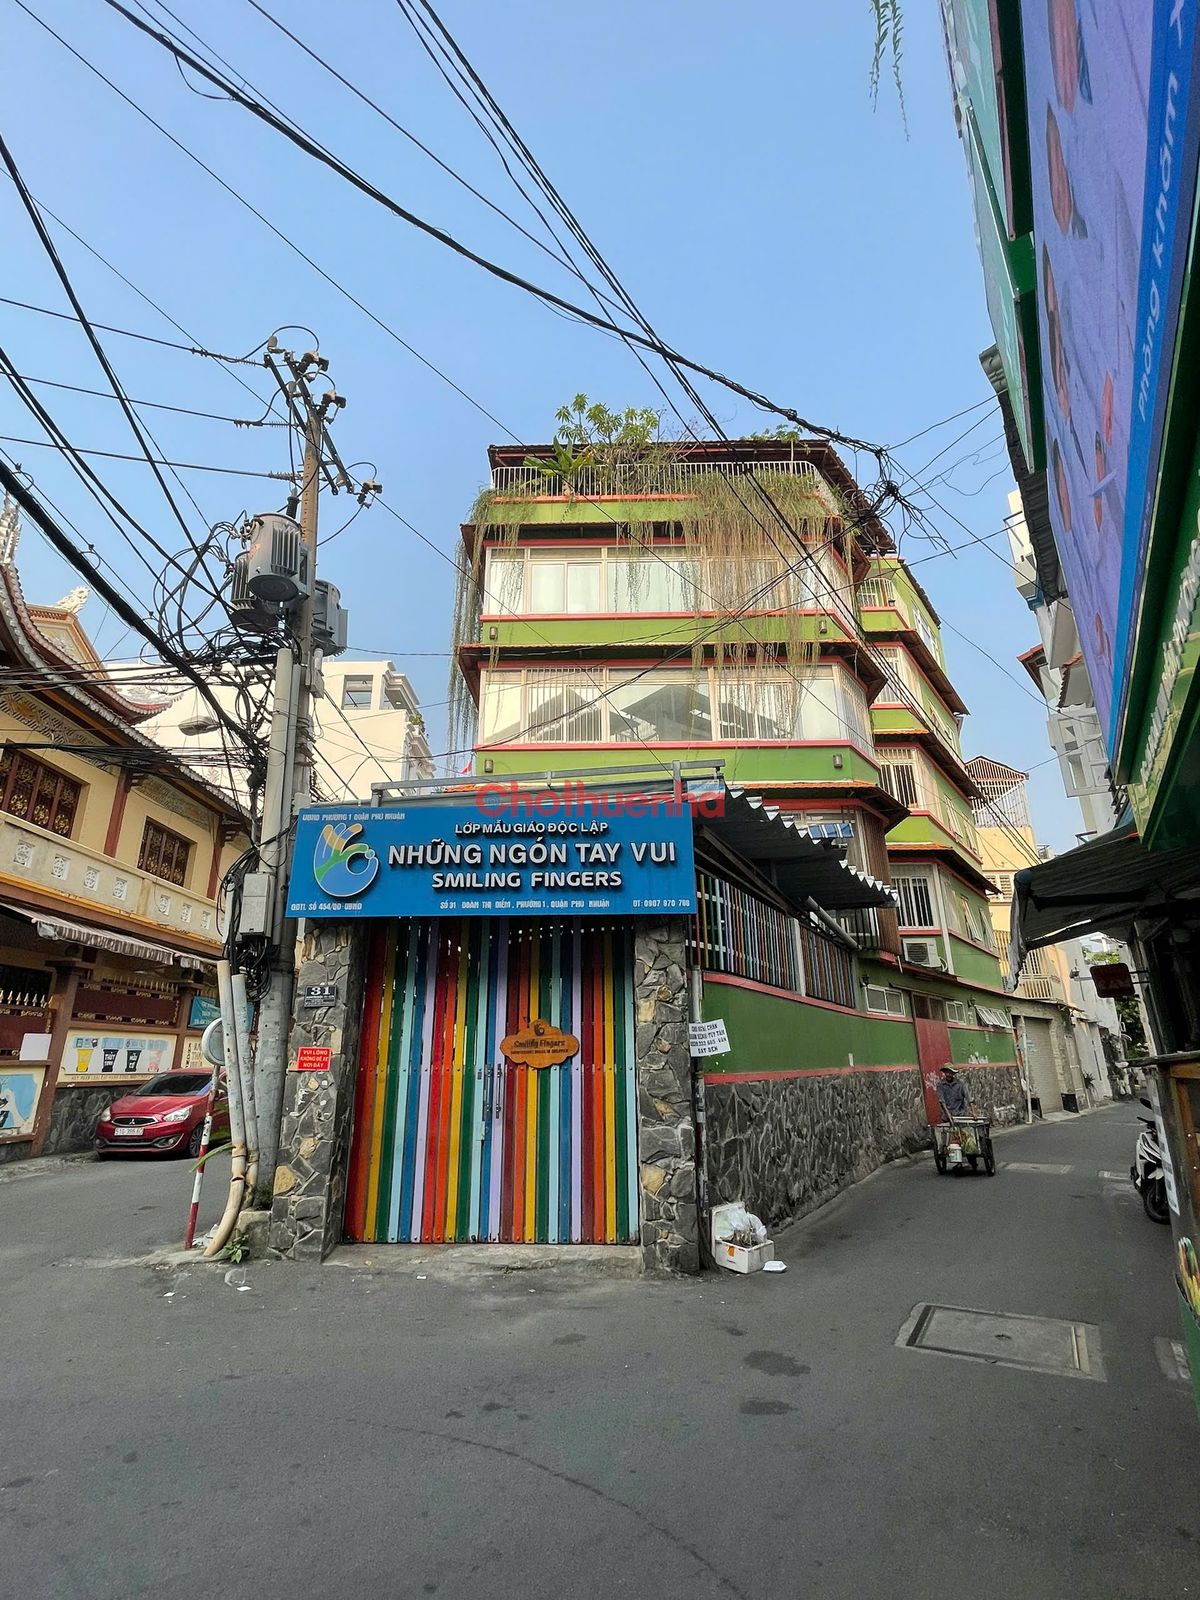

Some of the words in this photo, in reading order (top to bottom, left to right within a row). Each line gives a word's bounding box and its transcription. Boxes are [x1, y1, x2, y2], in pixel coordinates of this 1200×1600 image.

[455, 821, 481, 834] LỚP
[482, 820, 512, 834] MẪU
[513, 821, 545, 833] GIÁO
[547, 821, 578, 835] ĐỘC
[581, 820, 608, 835] LẬP
[388, 838, 482, 865] NHỮNG
[489, 836, 567, 864] NGÓN
[575, 843, 621, 863] TAY
[631, 842, 676, 862] VUI
[432, 872, 521, 888] SMILING
[531, 871, 622, 887] FINGERS
[449, 901, 456, 909] 31
[663, 899, 676, 907] 970
[310, 986, 331, 995] 31
